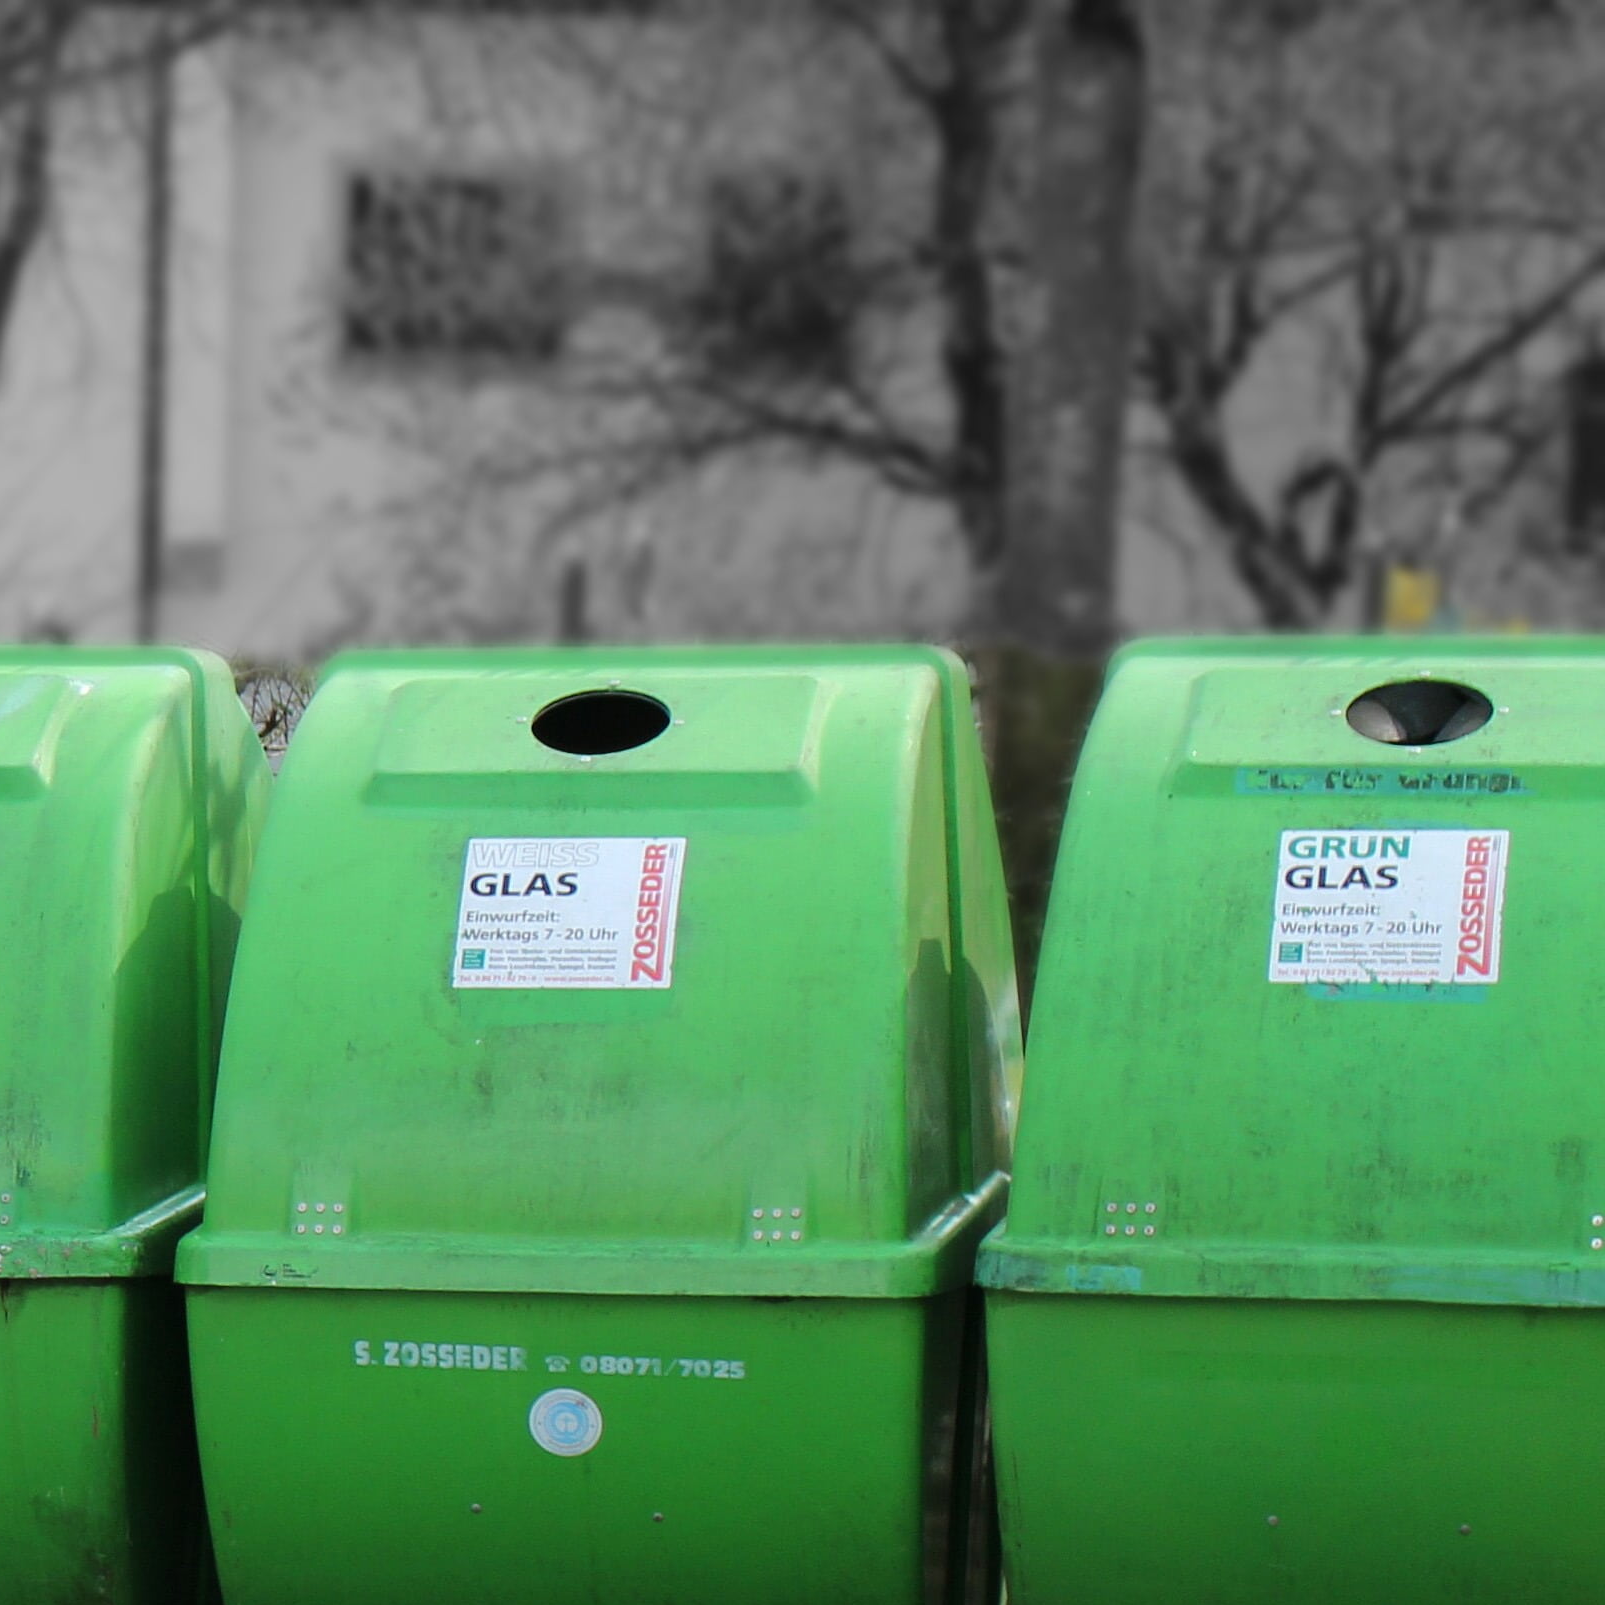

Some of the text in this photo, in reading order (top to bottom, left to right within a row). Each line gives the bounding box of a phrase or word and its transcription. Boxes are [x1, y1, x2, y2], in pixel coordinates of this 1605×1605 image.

[472, 842, 600, 868] WEISS
[469, 872, 579, 897] GLAS
[1285, 865, 1399, 889] GLAS
[465, 910, 561, 923] Einwurfzeit:
[630, 843, 668, 982] ZOSSEDER
[1456, 836, 1491, 976] ZOSSEDER
[463, 928, 539, 944] Werktags
[589, 928, 618, 941] Uhr
[1280, 921, 1359, 937] Werktags
[1412, 921, 1442, 934] Uhr
[384, 1341, 528, 1372] ZOSSEDER
